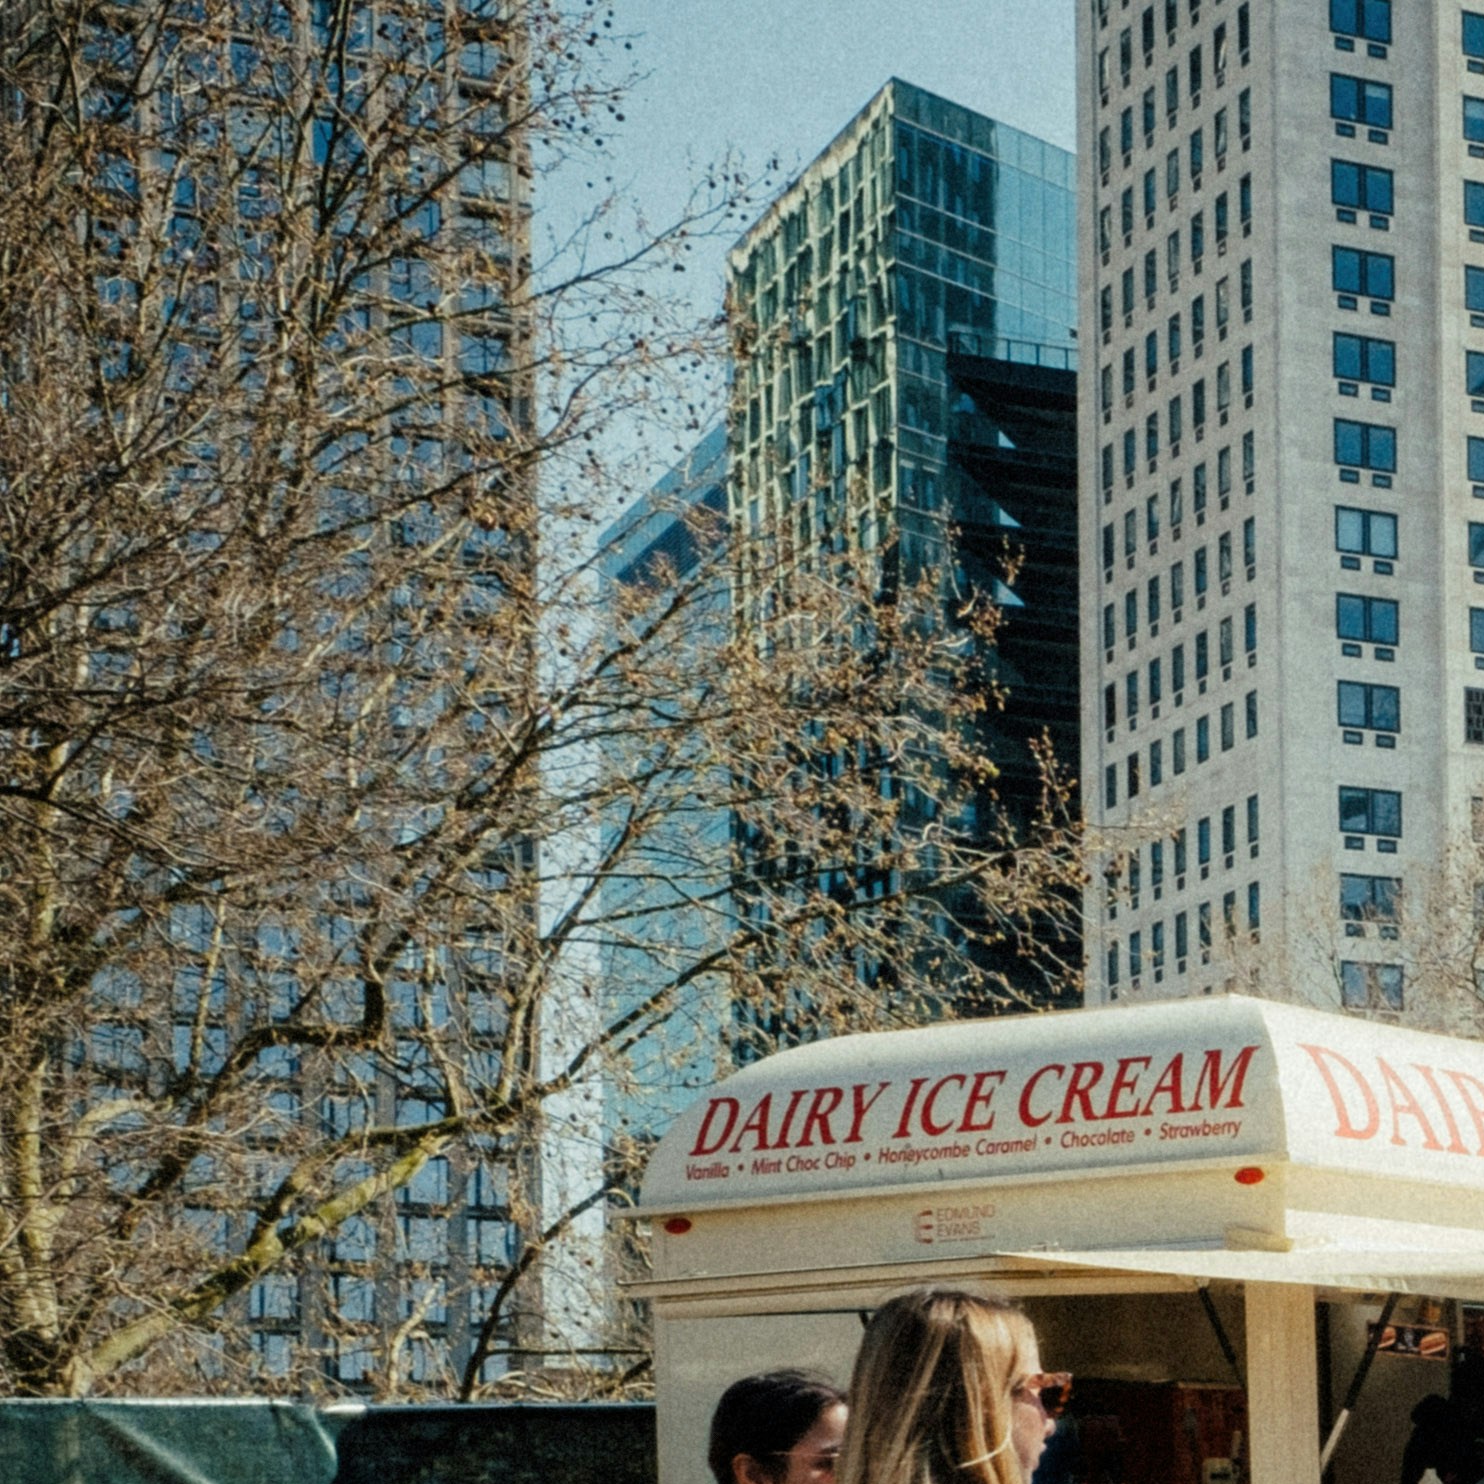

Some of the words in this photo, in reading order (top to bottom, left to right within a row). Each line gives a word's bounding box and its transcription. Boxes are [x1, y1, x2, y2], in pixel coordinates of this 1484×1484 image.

[689, 1080, 891, 1157] DAIRY
[892, 1069, 1008, 1138] ICE
[1018, 1045, 1261, 1128] CREAM
[685, 1161, 730, 1180] Vanilla
[751, 1156, 783, 1175] Mint
[786, 1153, 820, 1173] Choc
[823, 1150, 856, 1171] Chip
[878, 1142, 971, 1167] Honeycombe
[975, 1135, 1037, 1156] Caramel
[1060, 1128, 1135, 1149] Chocolate
[1158, 1119, 1242, 1145] Strawberry
